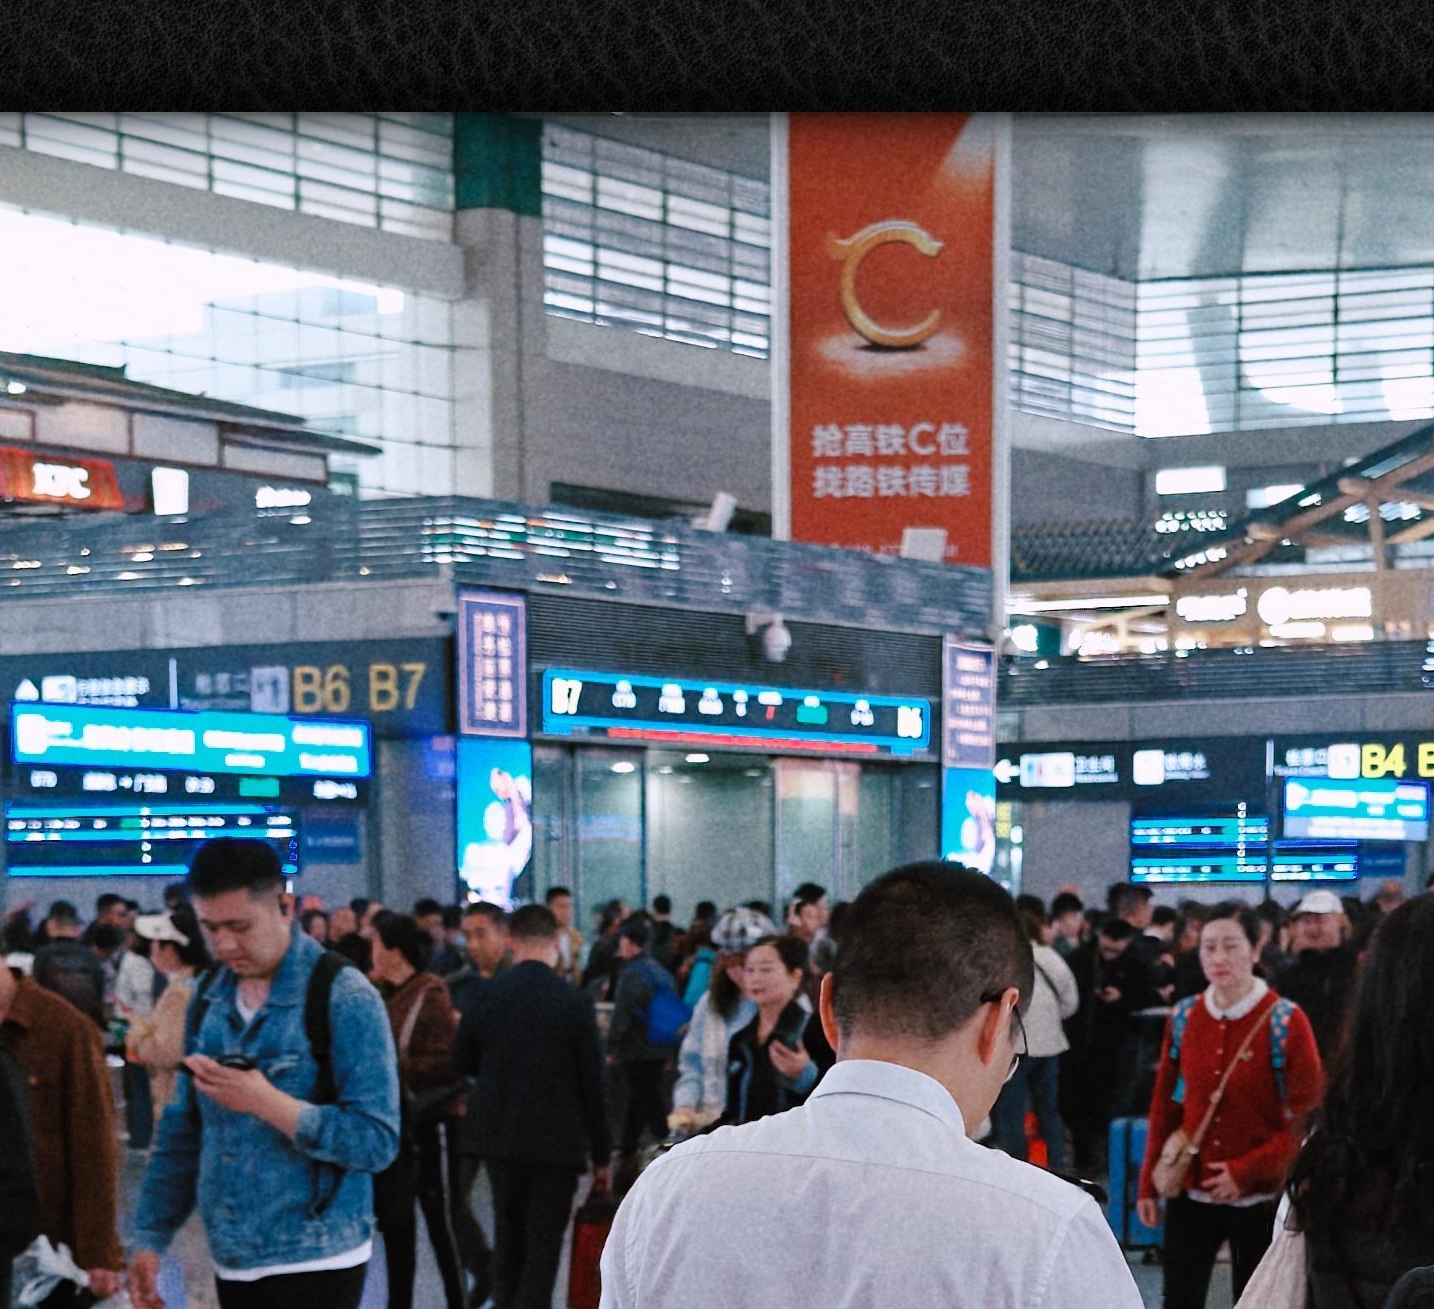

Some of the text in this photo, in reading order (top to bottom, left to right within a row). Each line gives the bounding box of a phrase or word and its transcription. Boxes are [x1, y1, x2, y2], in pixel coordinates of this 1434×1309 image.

[292, 664, 351, 713] B6
[368, 662, 427, 712] B7
[1361, 743, 1407, 778] B4
